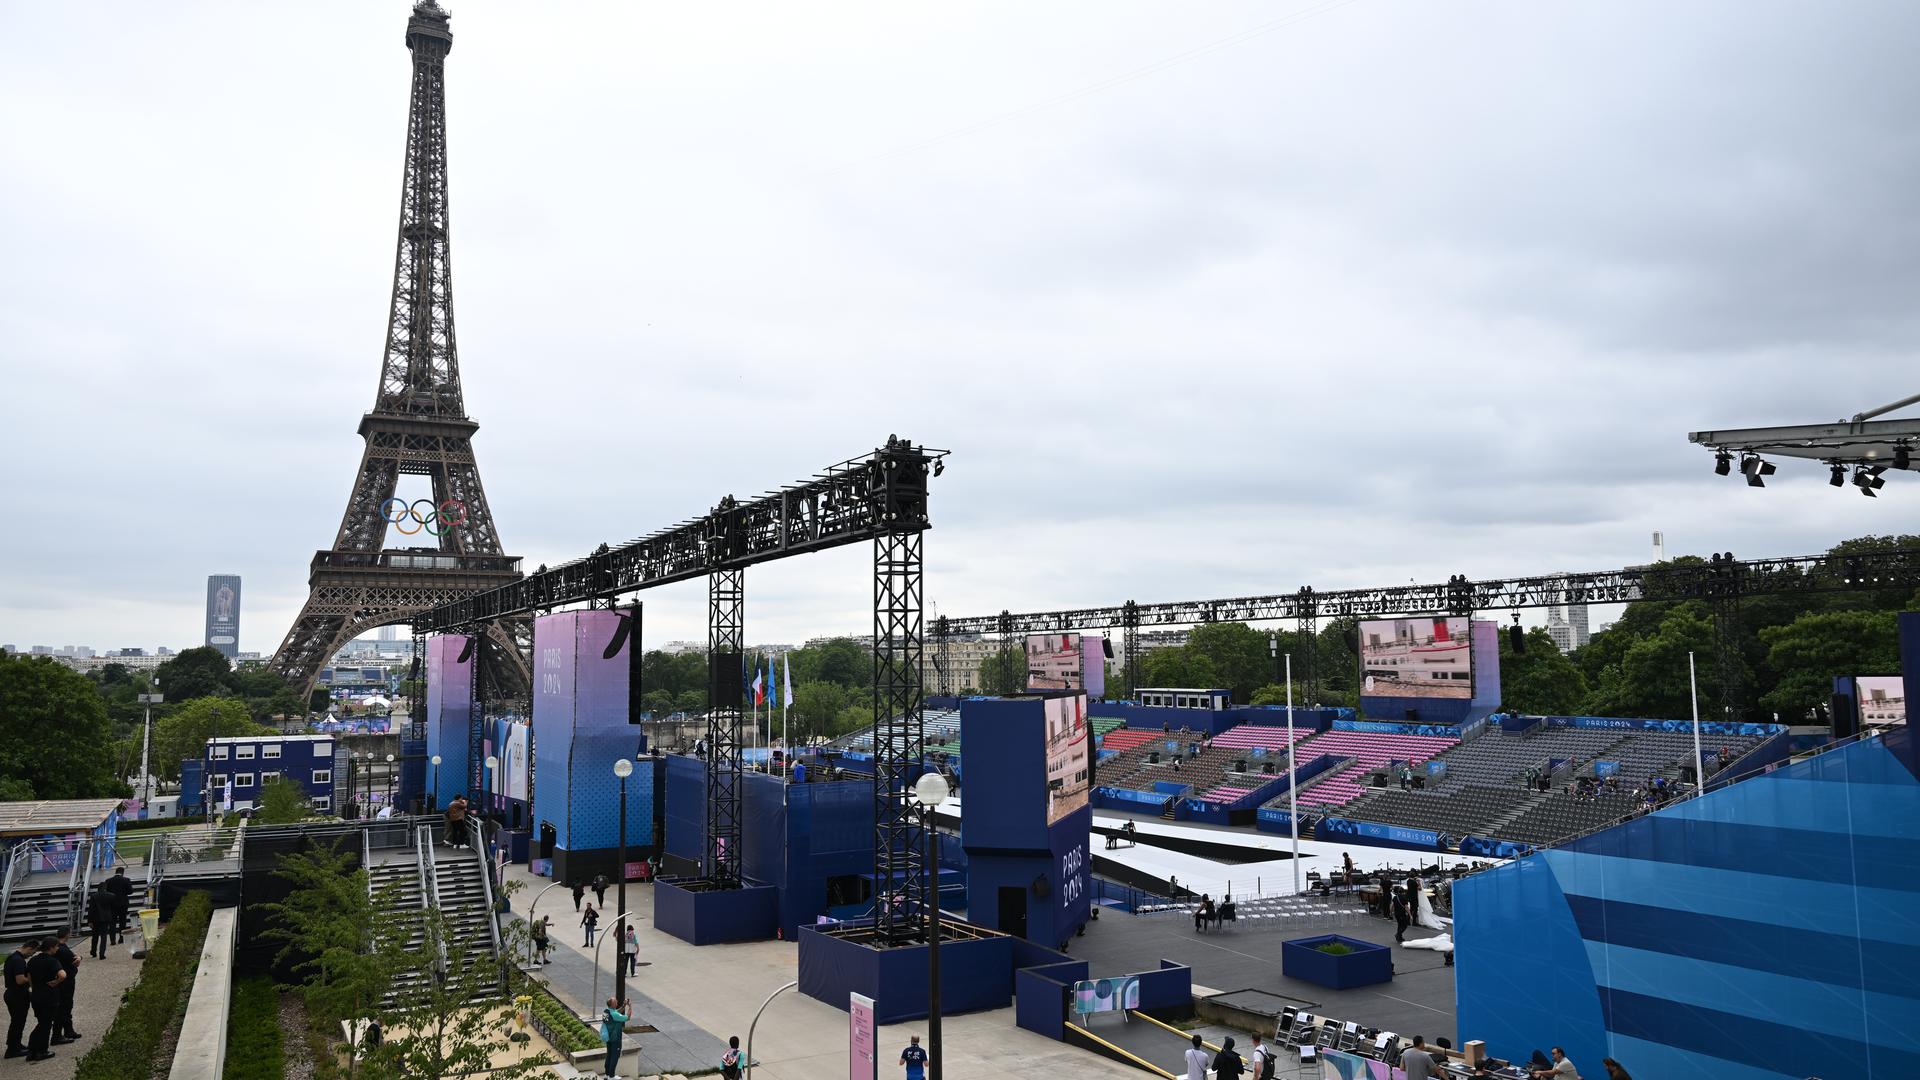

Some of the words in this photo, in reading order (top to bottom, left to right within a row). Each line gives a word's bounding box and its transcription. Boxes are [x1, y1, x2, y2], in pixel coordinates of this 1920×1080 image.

[543, 647, 561, 669] PARIS
[543, 673, 561, 694] 2024
[1265, 812, 1282, 821] PARIS
[1397, 831, 1419, 841] PARIS
[1421, 834, 1437, 843] 202
[1063, 844, 1082, 879] PARIS
[1063, 872, 1083, 908] 2024
